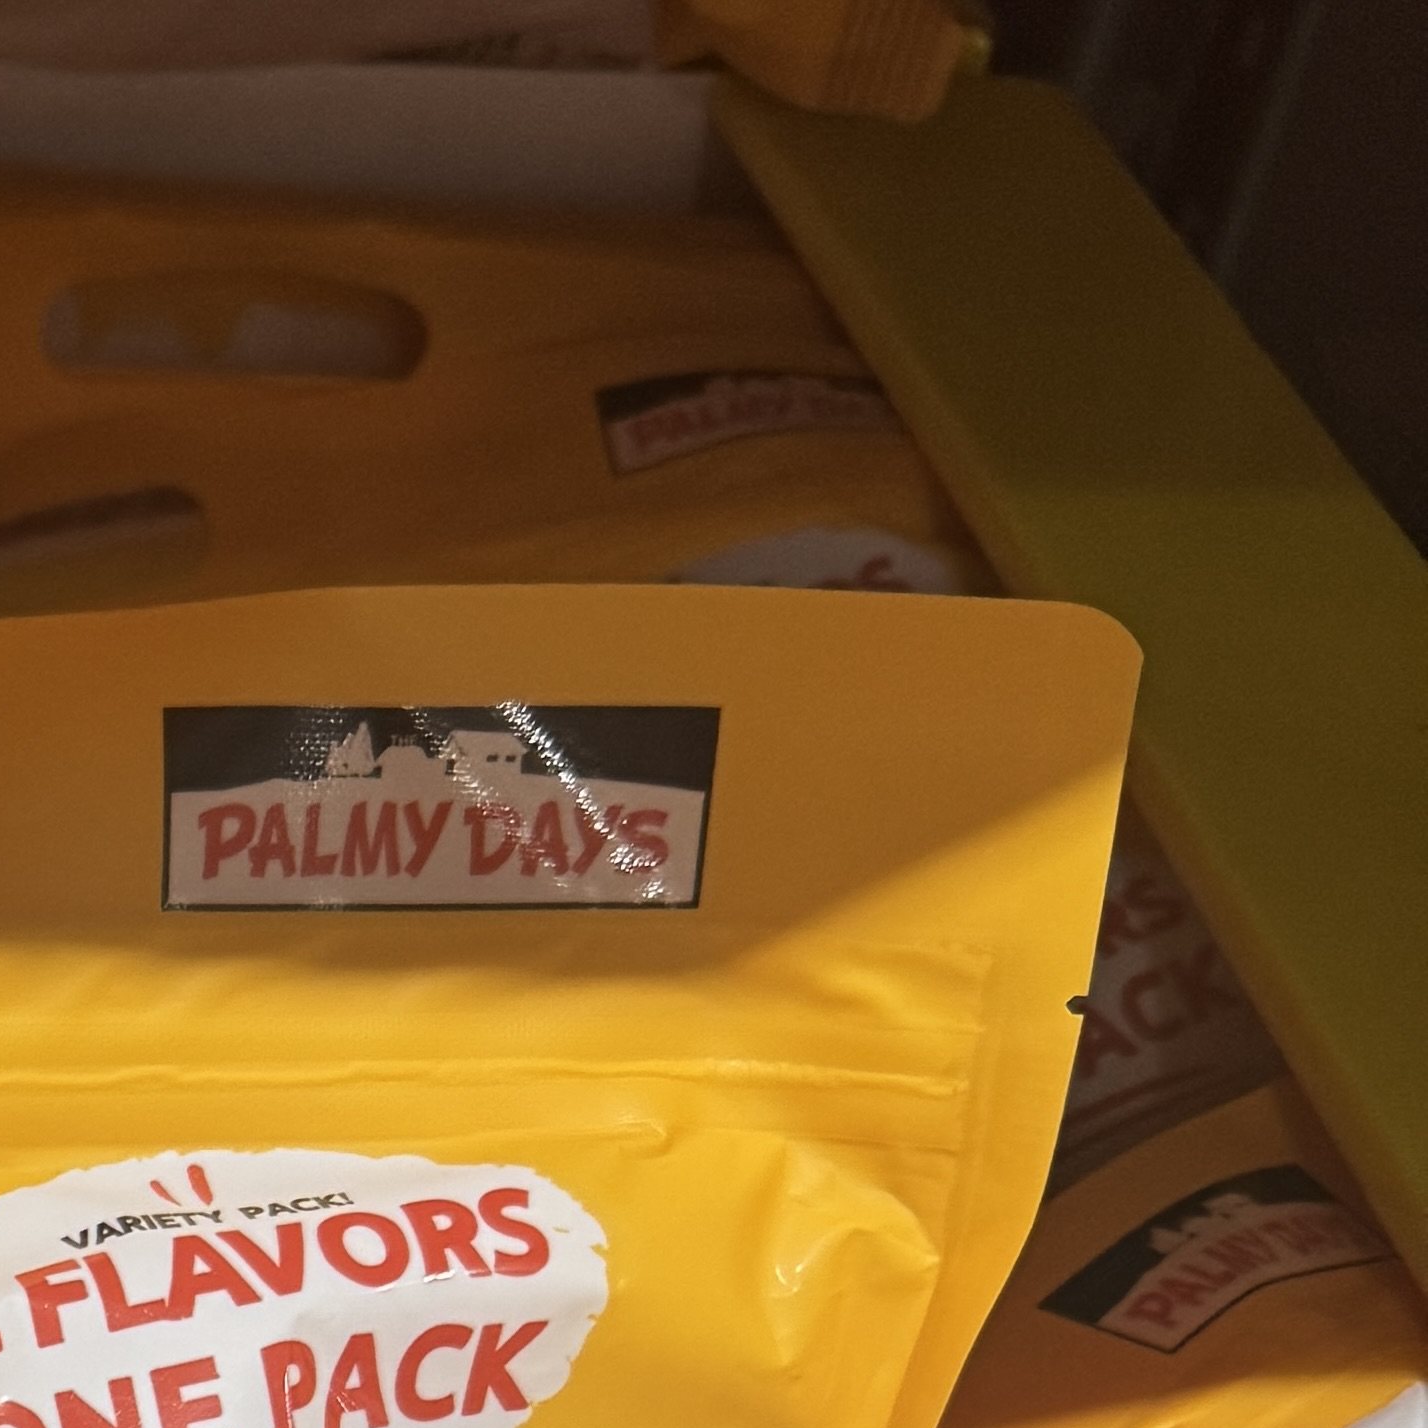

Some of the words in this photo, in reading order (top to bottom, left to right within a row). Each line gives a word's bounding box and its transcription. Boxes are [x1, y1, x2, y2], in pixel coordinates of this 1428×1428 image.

[197, 800, 454, 880] PALMY
[464, 800, 670, 877] DAYS
[60, 1209, 225, 1251] VARIETY
[239, 1191, 356, 1222] PACK!
[15, 1187, 550, 1349] FLAVORS
